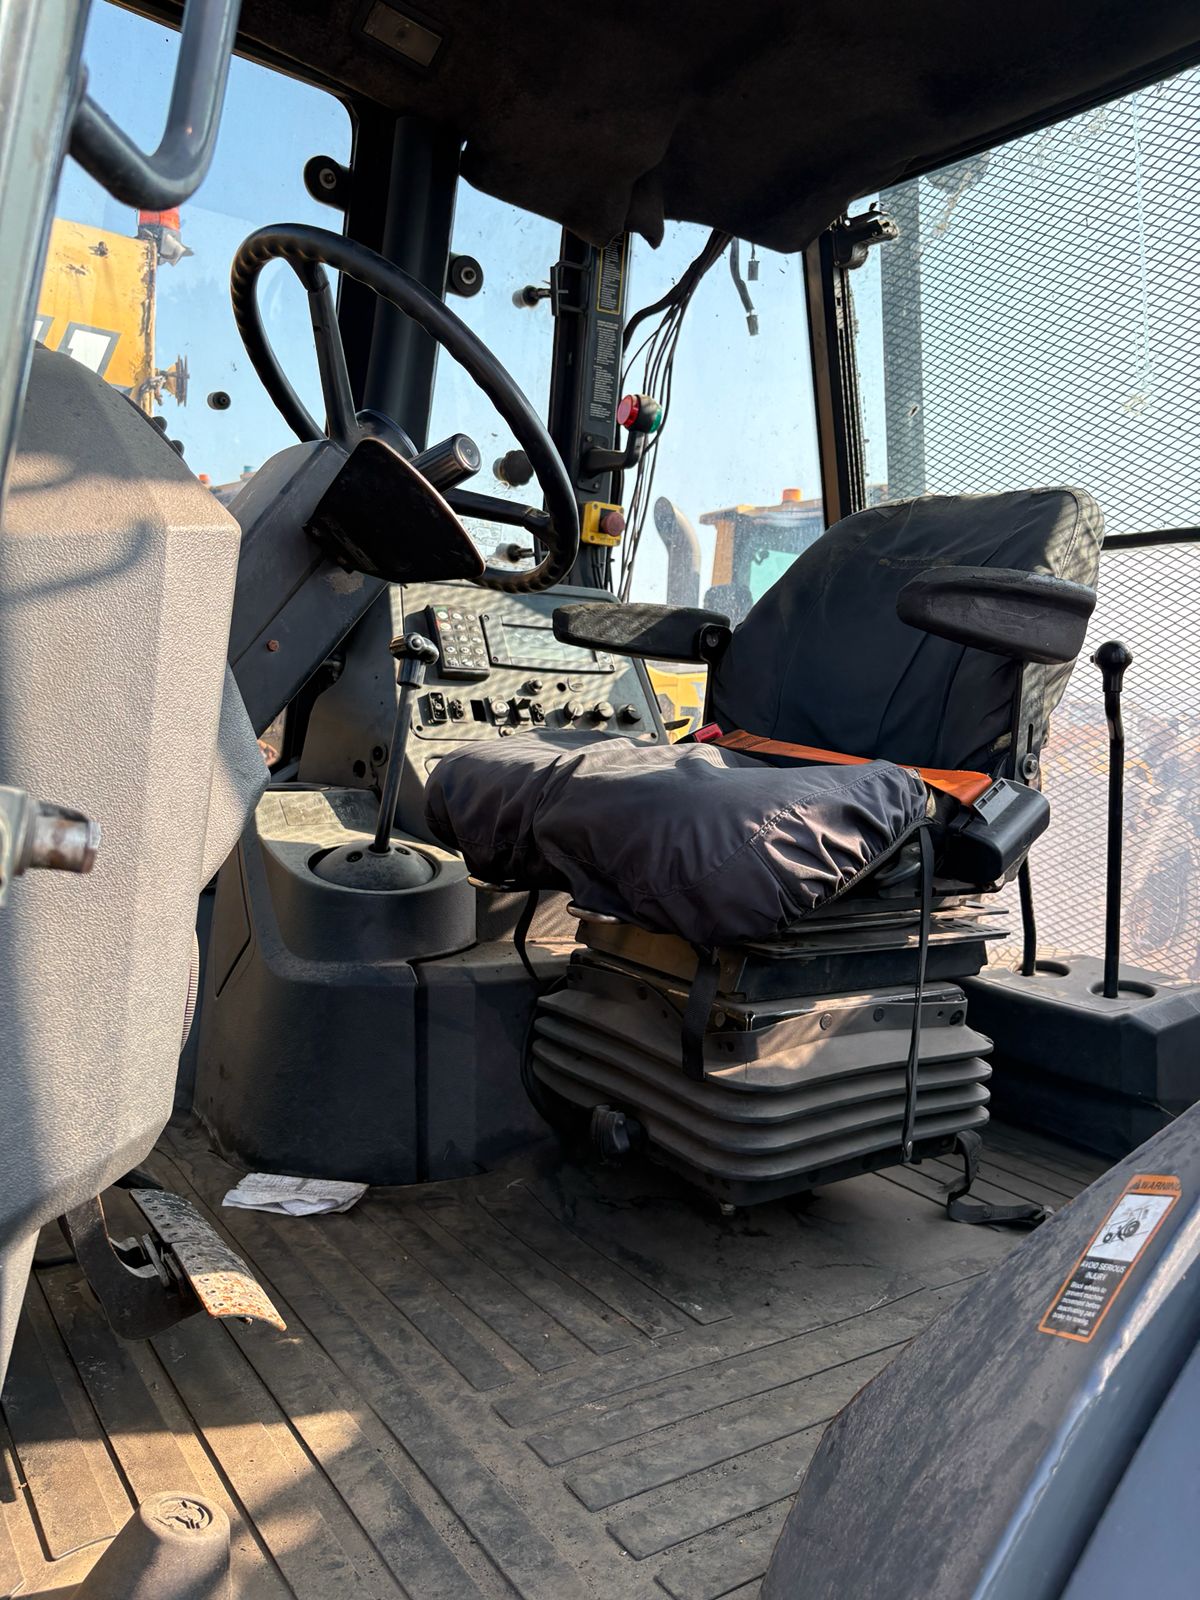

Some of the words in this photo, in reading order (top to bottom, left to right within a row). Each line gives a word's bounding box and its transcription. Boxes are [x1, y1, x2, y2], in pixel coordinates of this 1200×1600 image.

[1141, 1182, 1181, 1191] WARNING
[1080, 1261, 1099, 1270] AVOID
[1099, 1263, 1127, 1274] SERIOUS
[1085, 1272, 1108, 1281] INJURY
